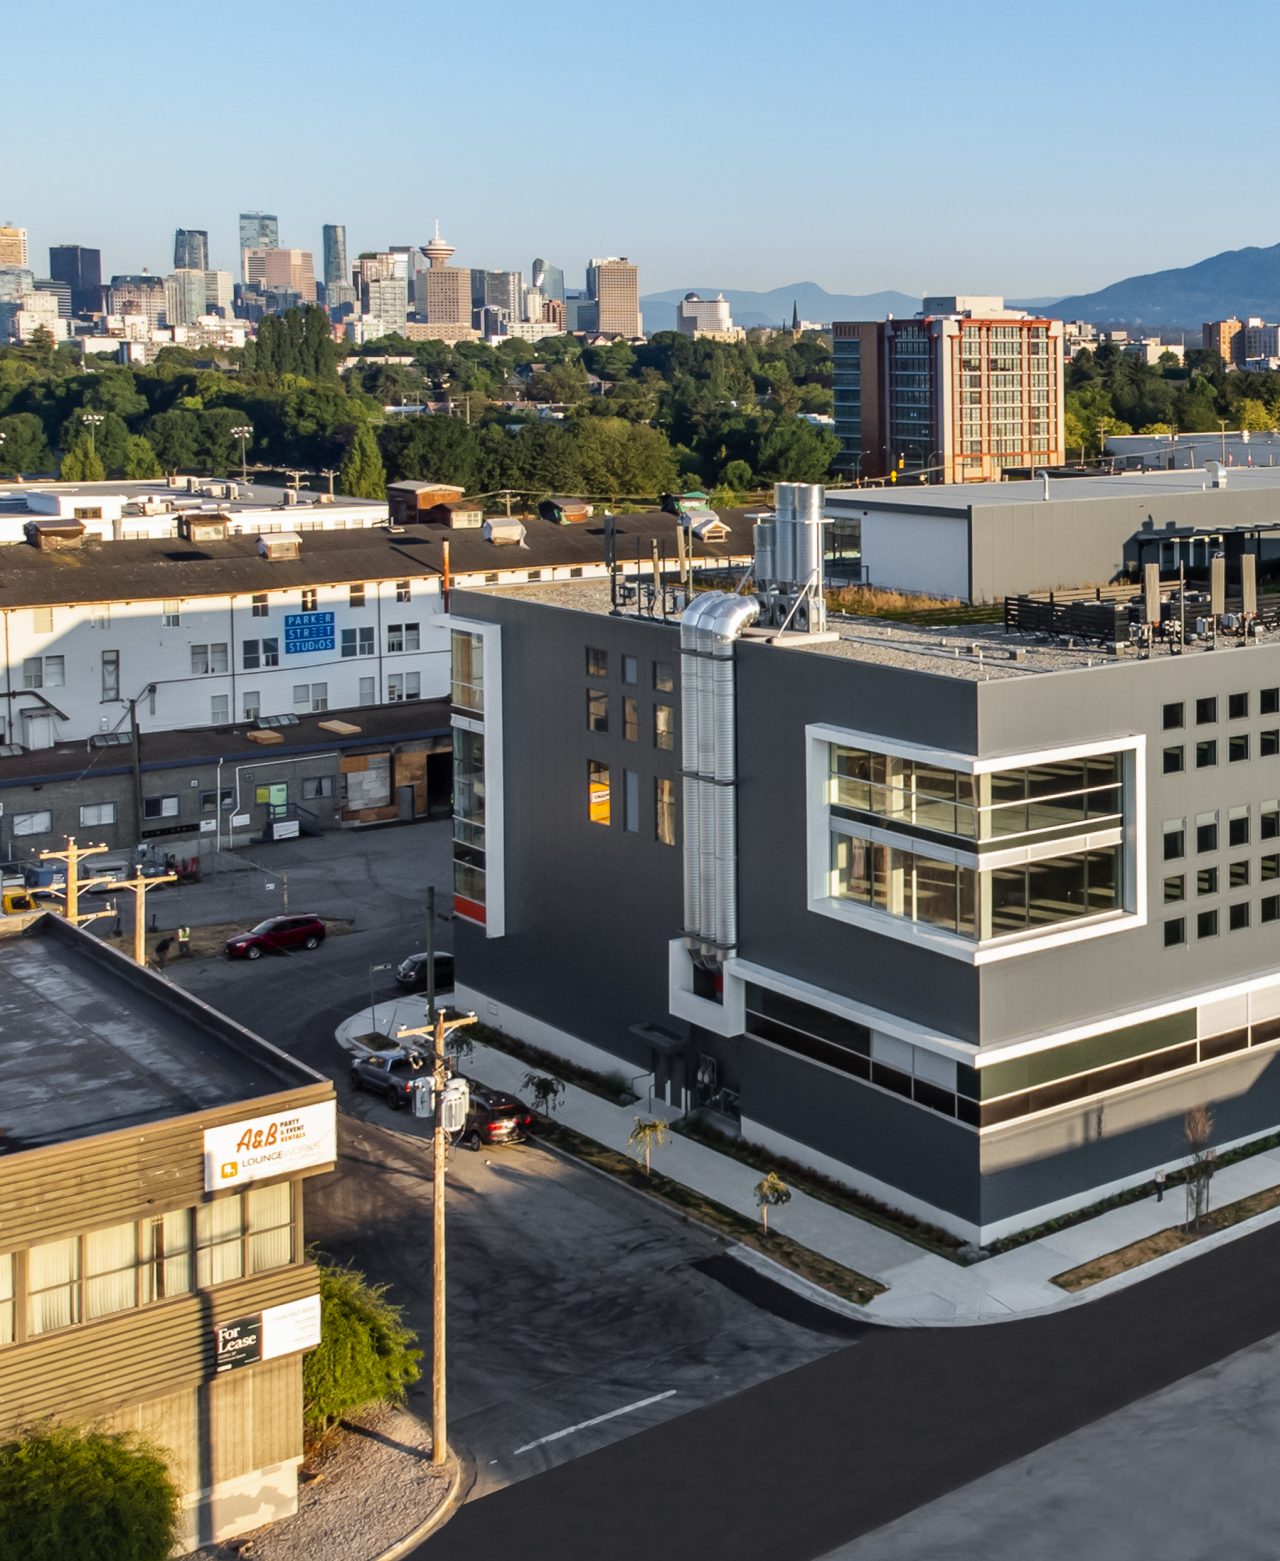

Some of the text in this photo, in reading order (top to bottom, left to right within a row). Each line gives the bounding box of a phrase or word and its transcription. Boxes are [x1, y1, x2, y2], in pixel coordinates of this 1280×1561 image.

[288, 614, 332, 625] PARKER
[289, 626, 332, 639] STREET
[280, 1119, 300, 1128] PARTY
[286, 1125, 305, 1134] EVENT
[236, 1122, 278, 1153] A&B
[280, 1132, 306, 1142] RENTALS
[218, 1327, 240, 1342] For
[218, 1334, 257, 1354] Lease
